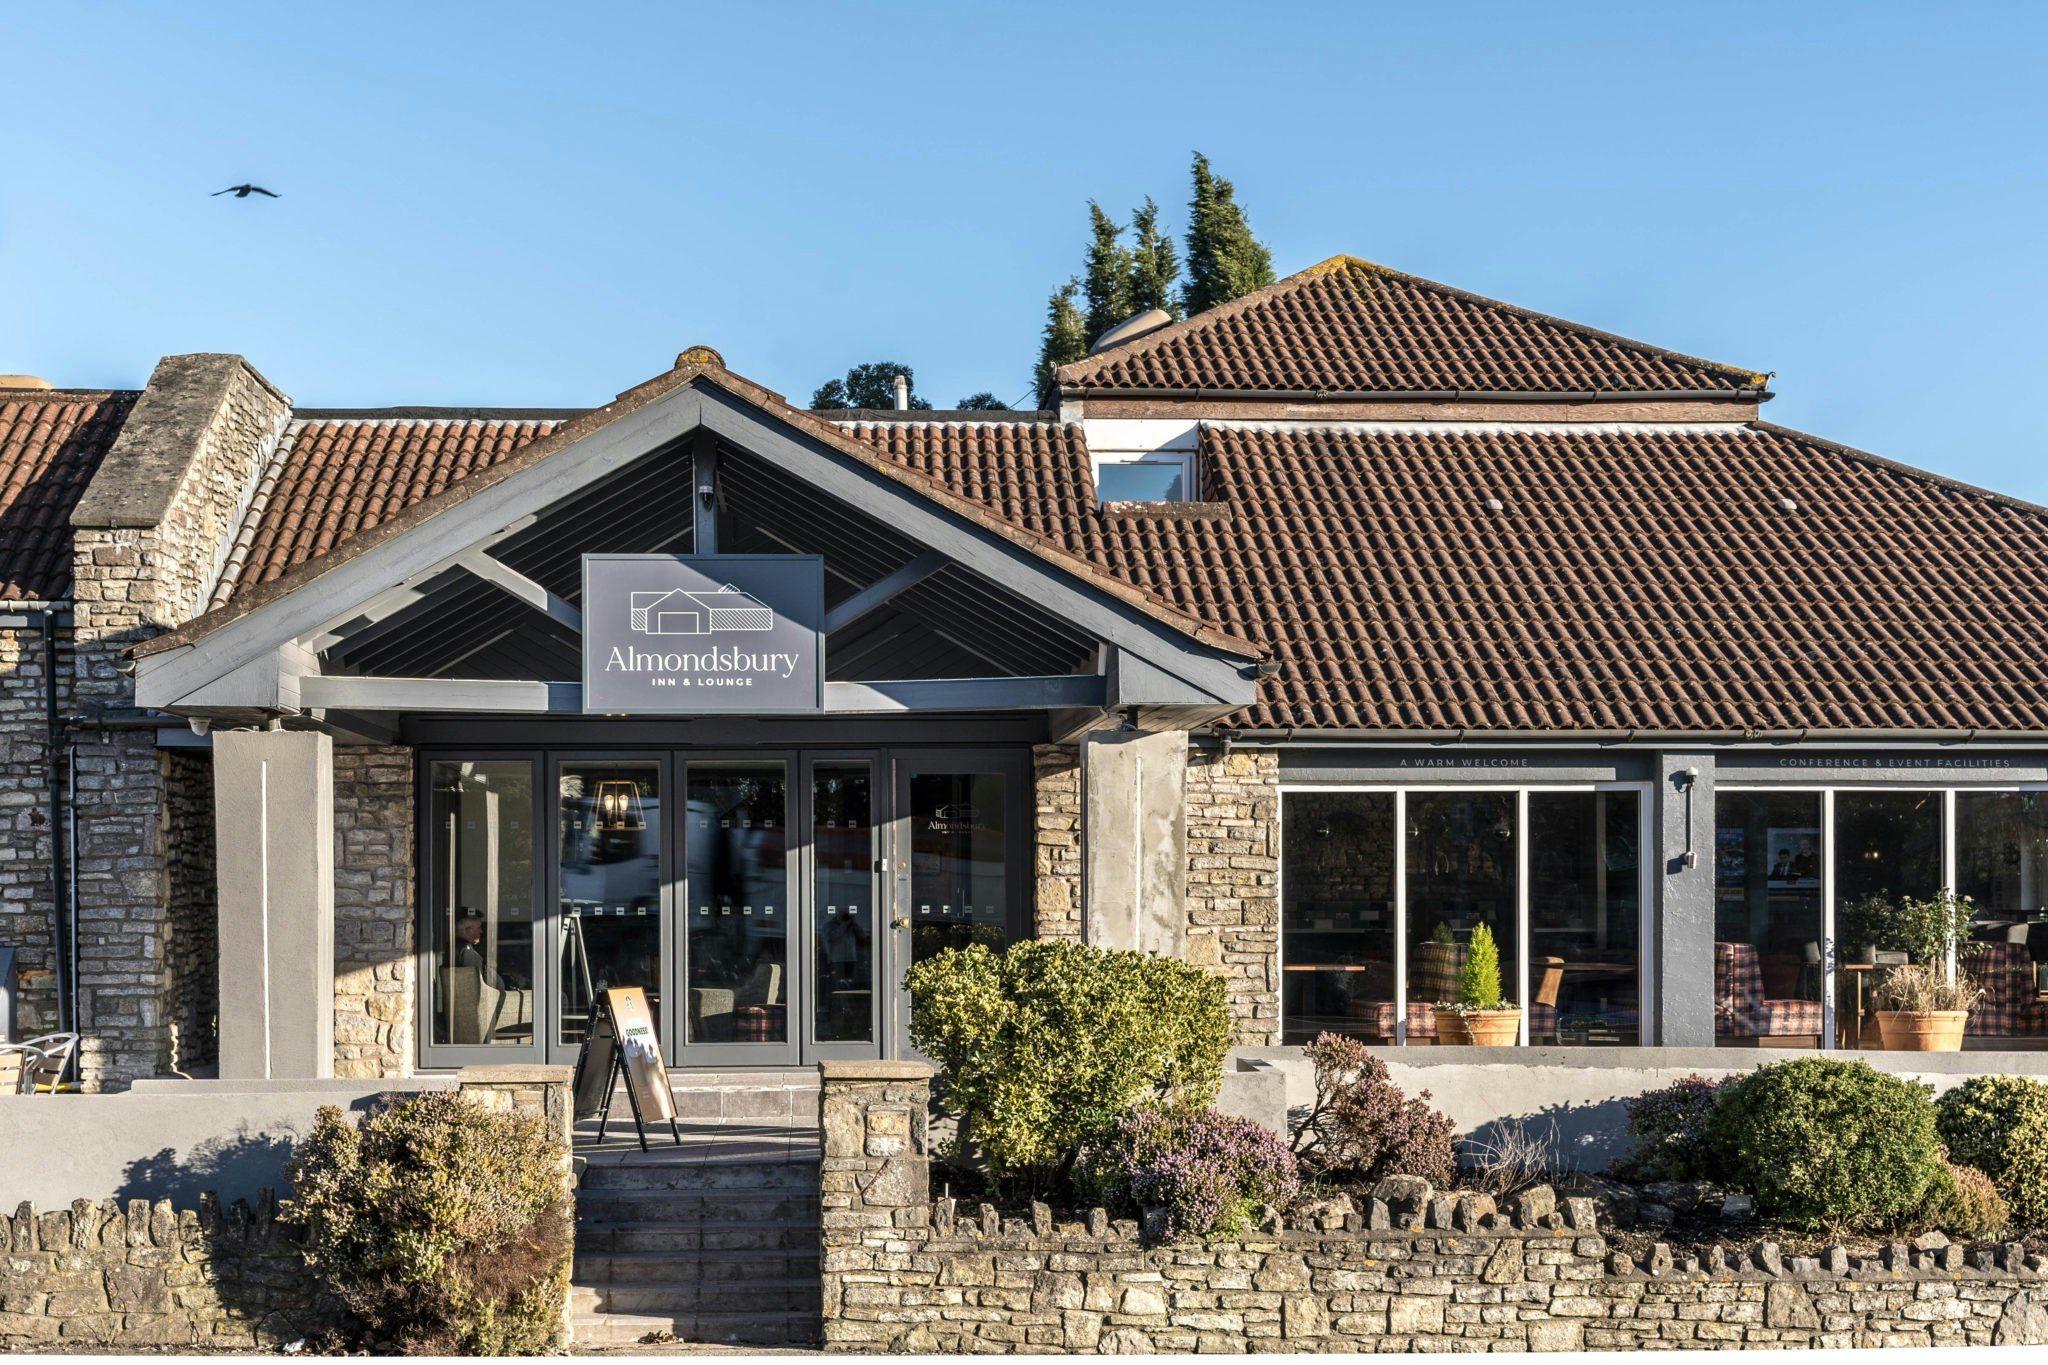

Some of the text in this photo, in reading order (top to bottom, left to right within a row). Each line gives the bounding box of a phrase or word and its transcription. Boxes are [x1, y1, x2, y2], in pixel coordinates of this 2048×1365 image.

[605, 646, 799, 678] Almondsbury
[652, 678, 753, 686] INN & LOUNGE
[1400, 759, 1528, 767] A WARM WELCOME
[1780, 759, 2010, 767] CONFERENCE & EVENT FACILITIES
